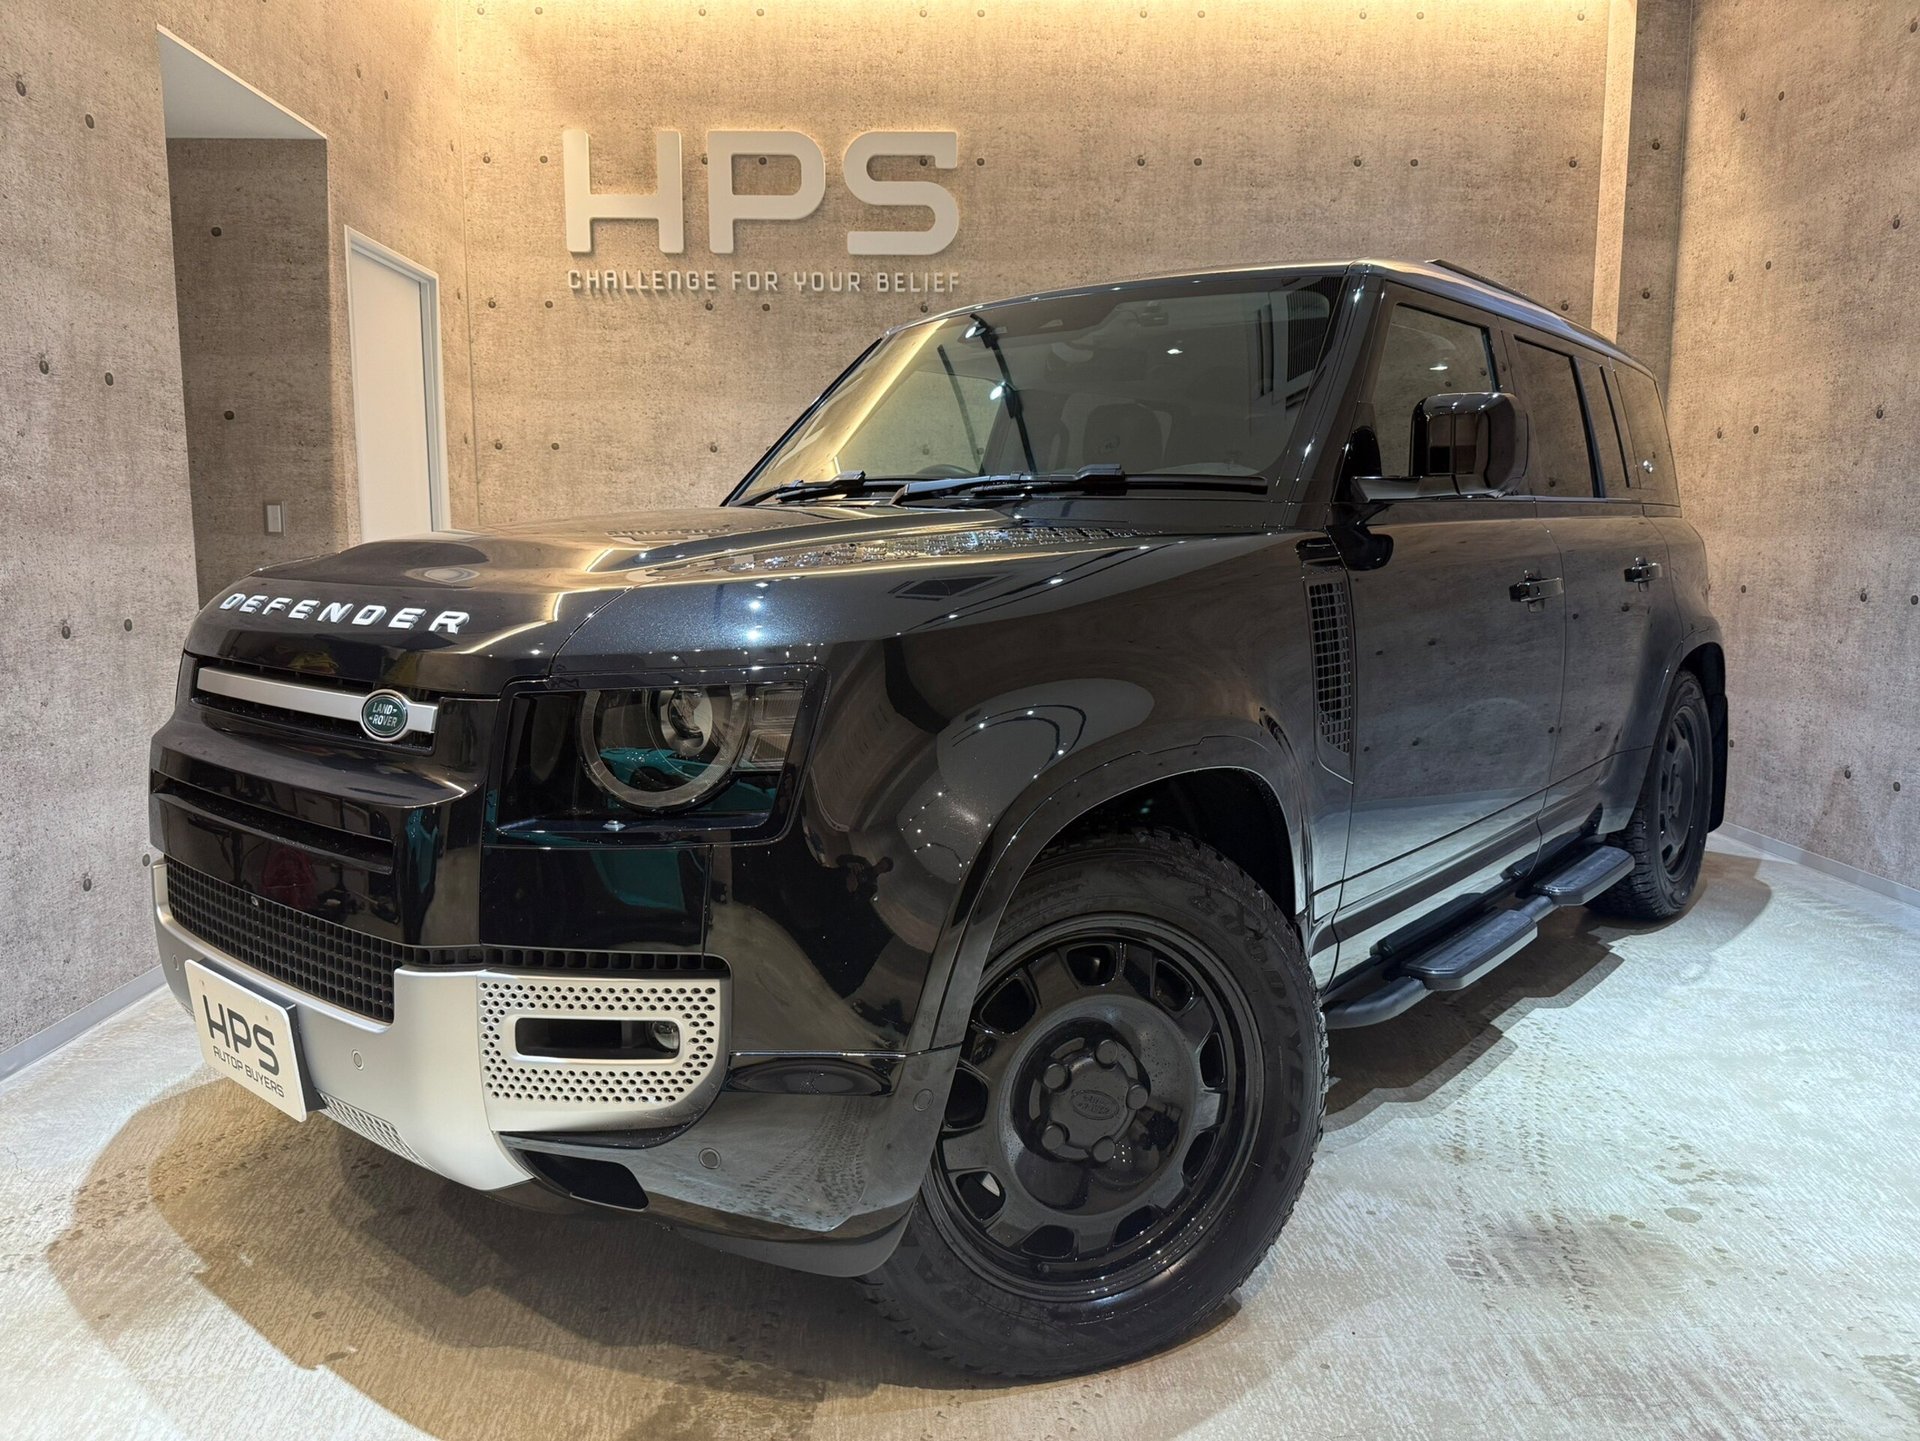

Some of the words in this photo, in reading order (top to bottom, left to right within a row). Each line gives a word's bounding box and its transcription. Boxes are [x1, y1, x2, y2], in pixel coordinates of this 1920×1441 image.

[562, 129, 960, 256] HPS
[567, 269, 717, 291] CHALLENGE
[731, 271, 779, 292] FOR
[793, 271, 861, 293] YOUR
[876, 272, 960, 293] BELIEF
[219, 592, 470, 635] DEFENDER
[372, 702, 393, 715] LAND
[372, 714, 398, 727] ROVER
[202, 994, 280, 1076] HPS
[244, 1063, 285, 1098] BUYERS
